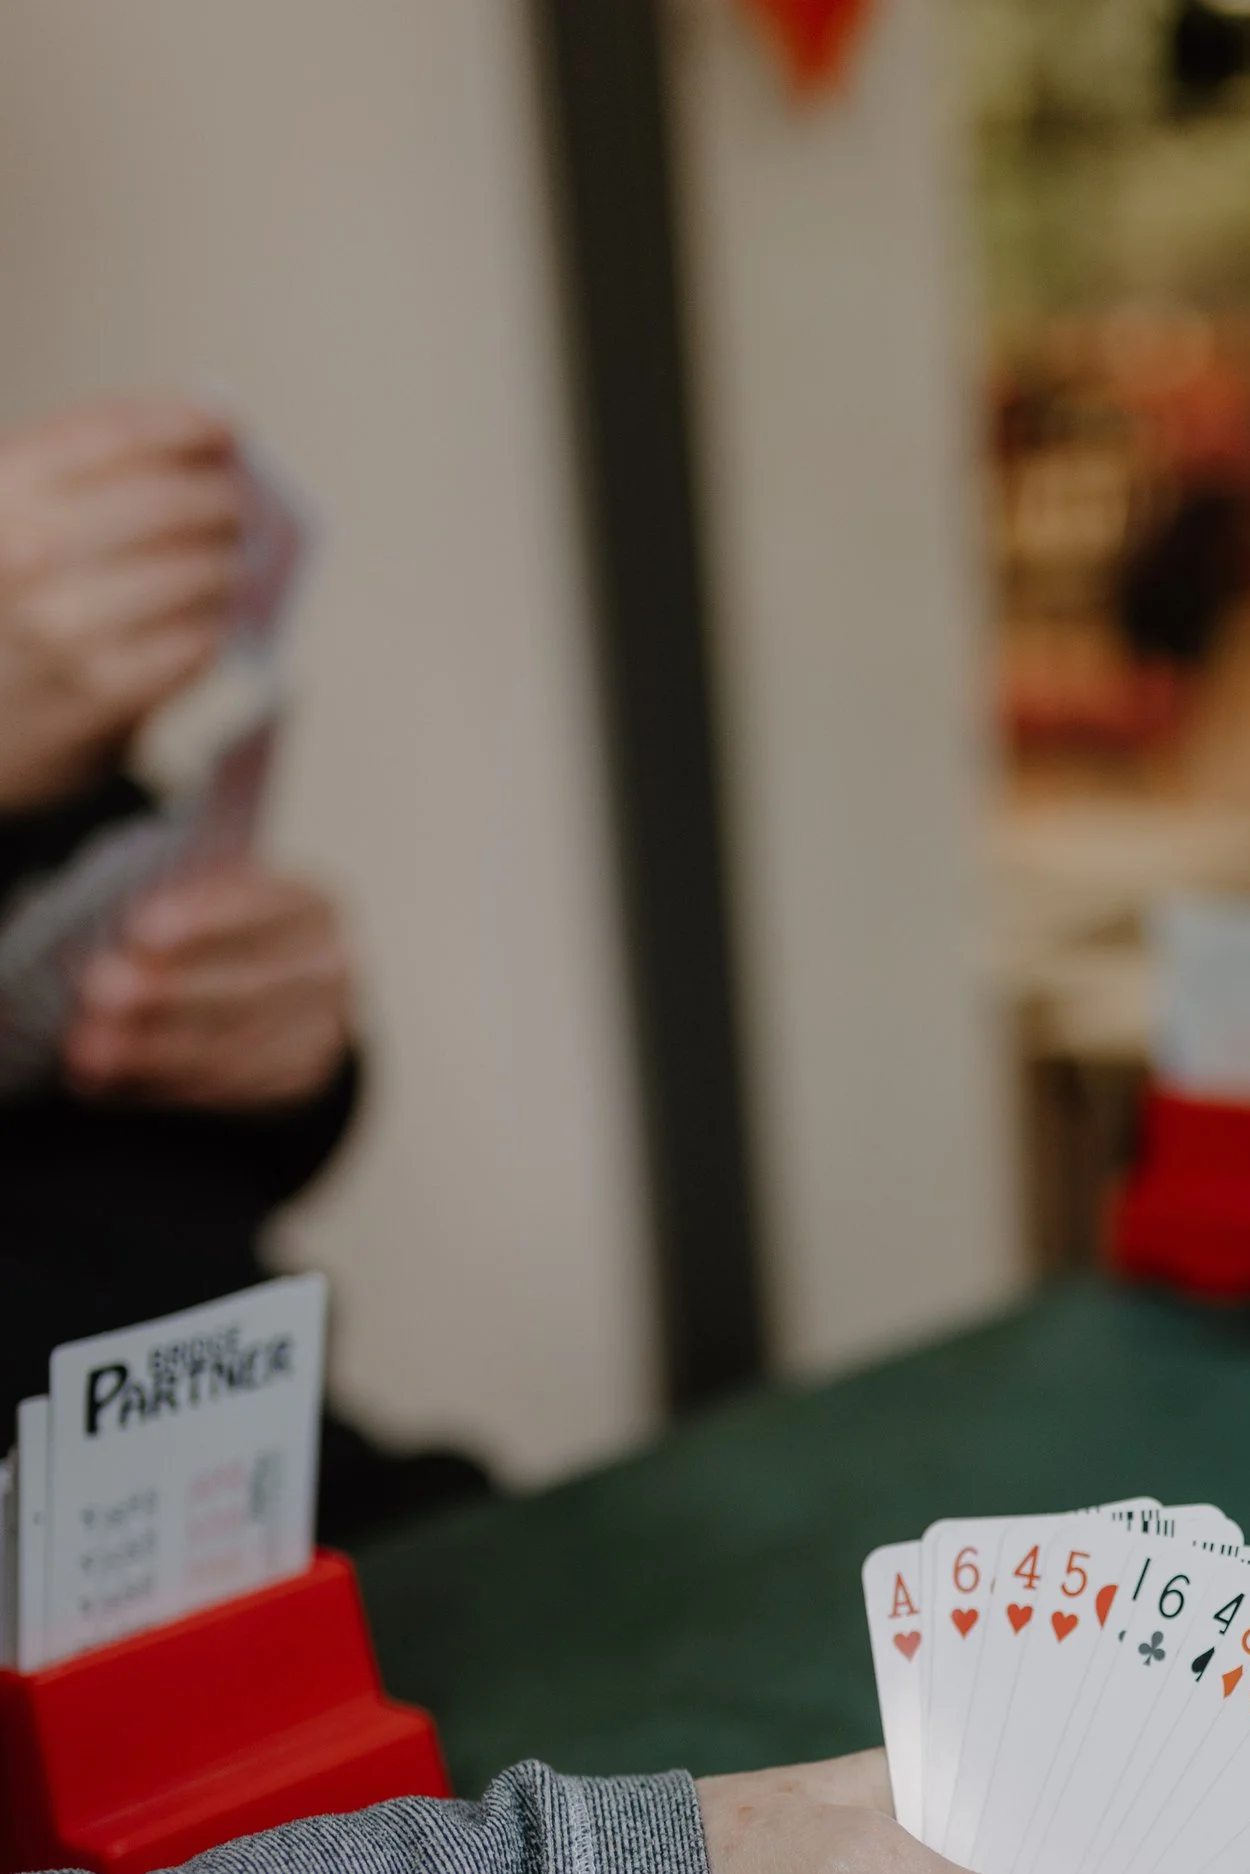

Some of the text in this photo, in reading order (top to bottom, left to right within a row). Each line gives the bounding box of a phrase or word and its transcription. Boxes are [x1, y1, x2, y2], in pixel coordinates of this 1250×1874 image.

[85, 1336, 293, 1437] PARTNER
[953, 1546, 980, 1594] 6
[1012, 1544, 1041, 1590] 4
[1060, 1550, 1091, 1597] 5
[888, 1571, 920, 1619] A
[1158, 1574, 1191, 1620] 6
[1212, 1592, 1246, 1636] 4
